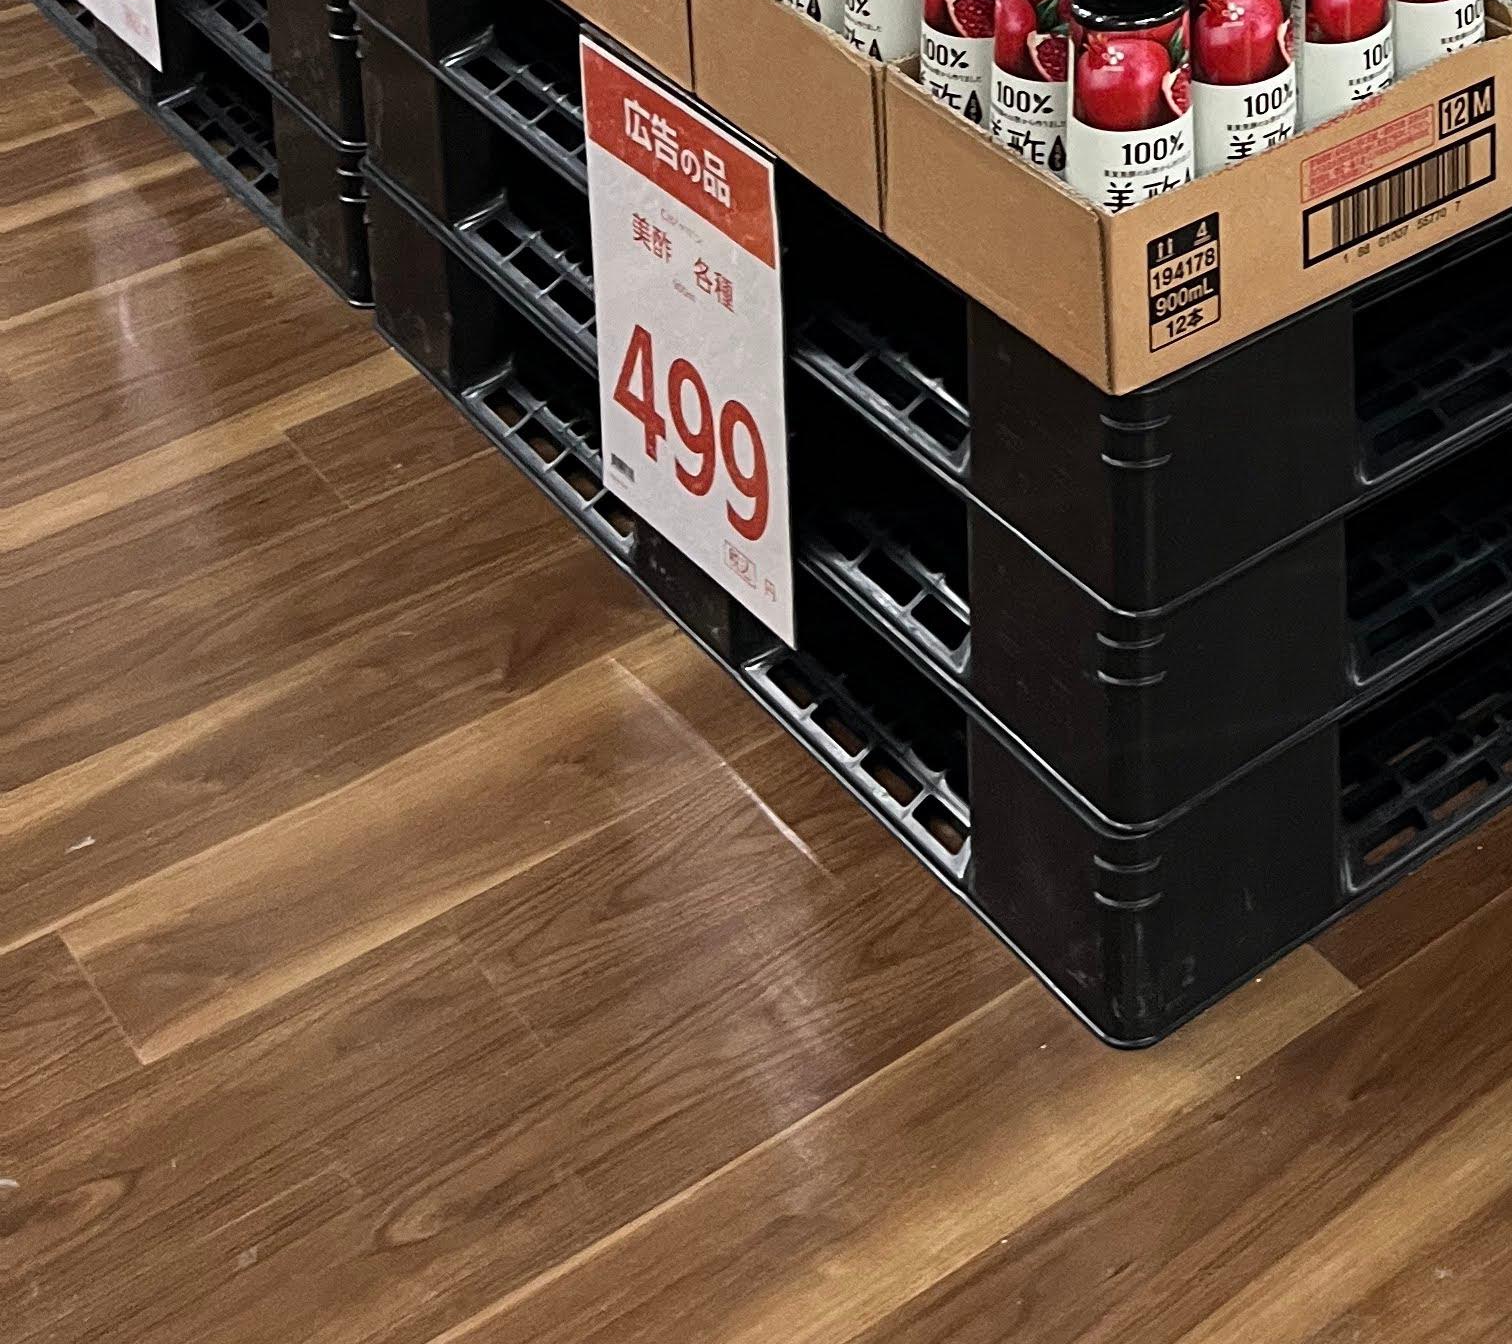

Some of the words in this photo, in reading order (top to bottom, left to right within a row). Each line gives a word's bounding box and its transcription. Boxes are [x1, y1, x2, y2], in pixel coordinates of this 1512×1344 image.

[996, 80, 1055, 115] 100%
[623, 97, 731, 209] 広告の品
[1121, 131, 1184, 167] 100%
[1194, 222, 1206, 242] 4
[633, 213, 672, 263] 美酢
[694, 258, 735, 313] 各種
[1152, 248, 1217, 287] 194178
[1156, 278, 1214, 317] 900mL
[1166, 309, 1204, 339] 12本
[613, 323, 770, 542] 499
